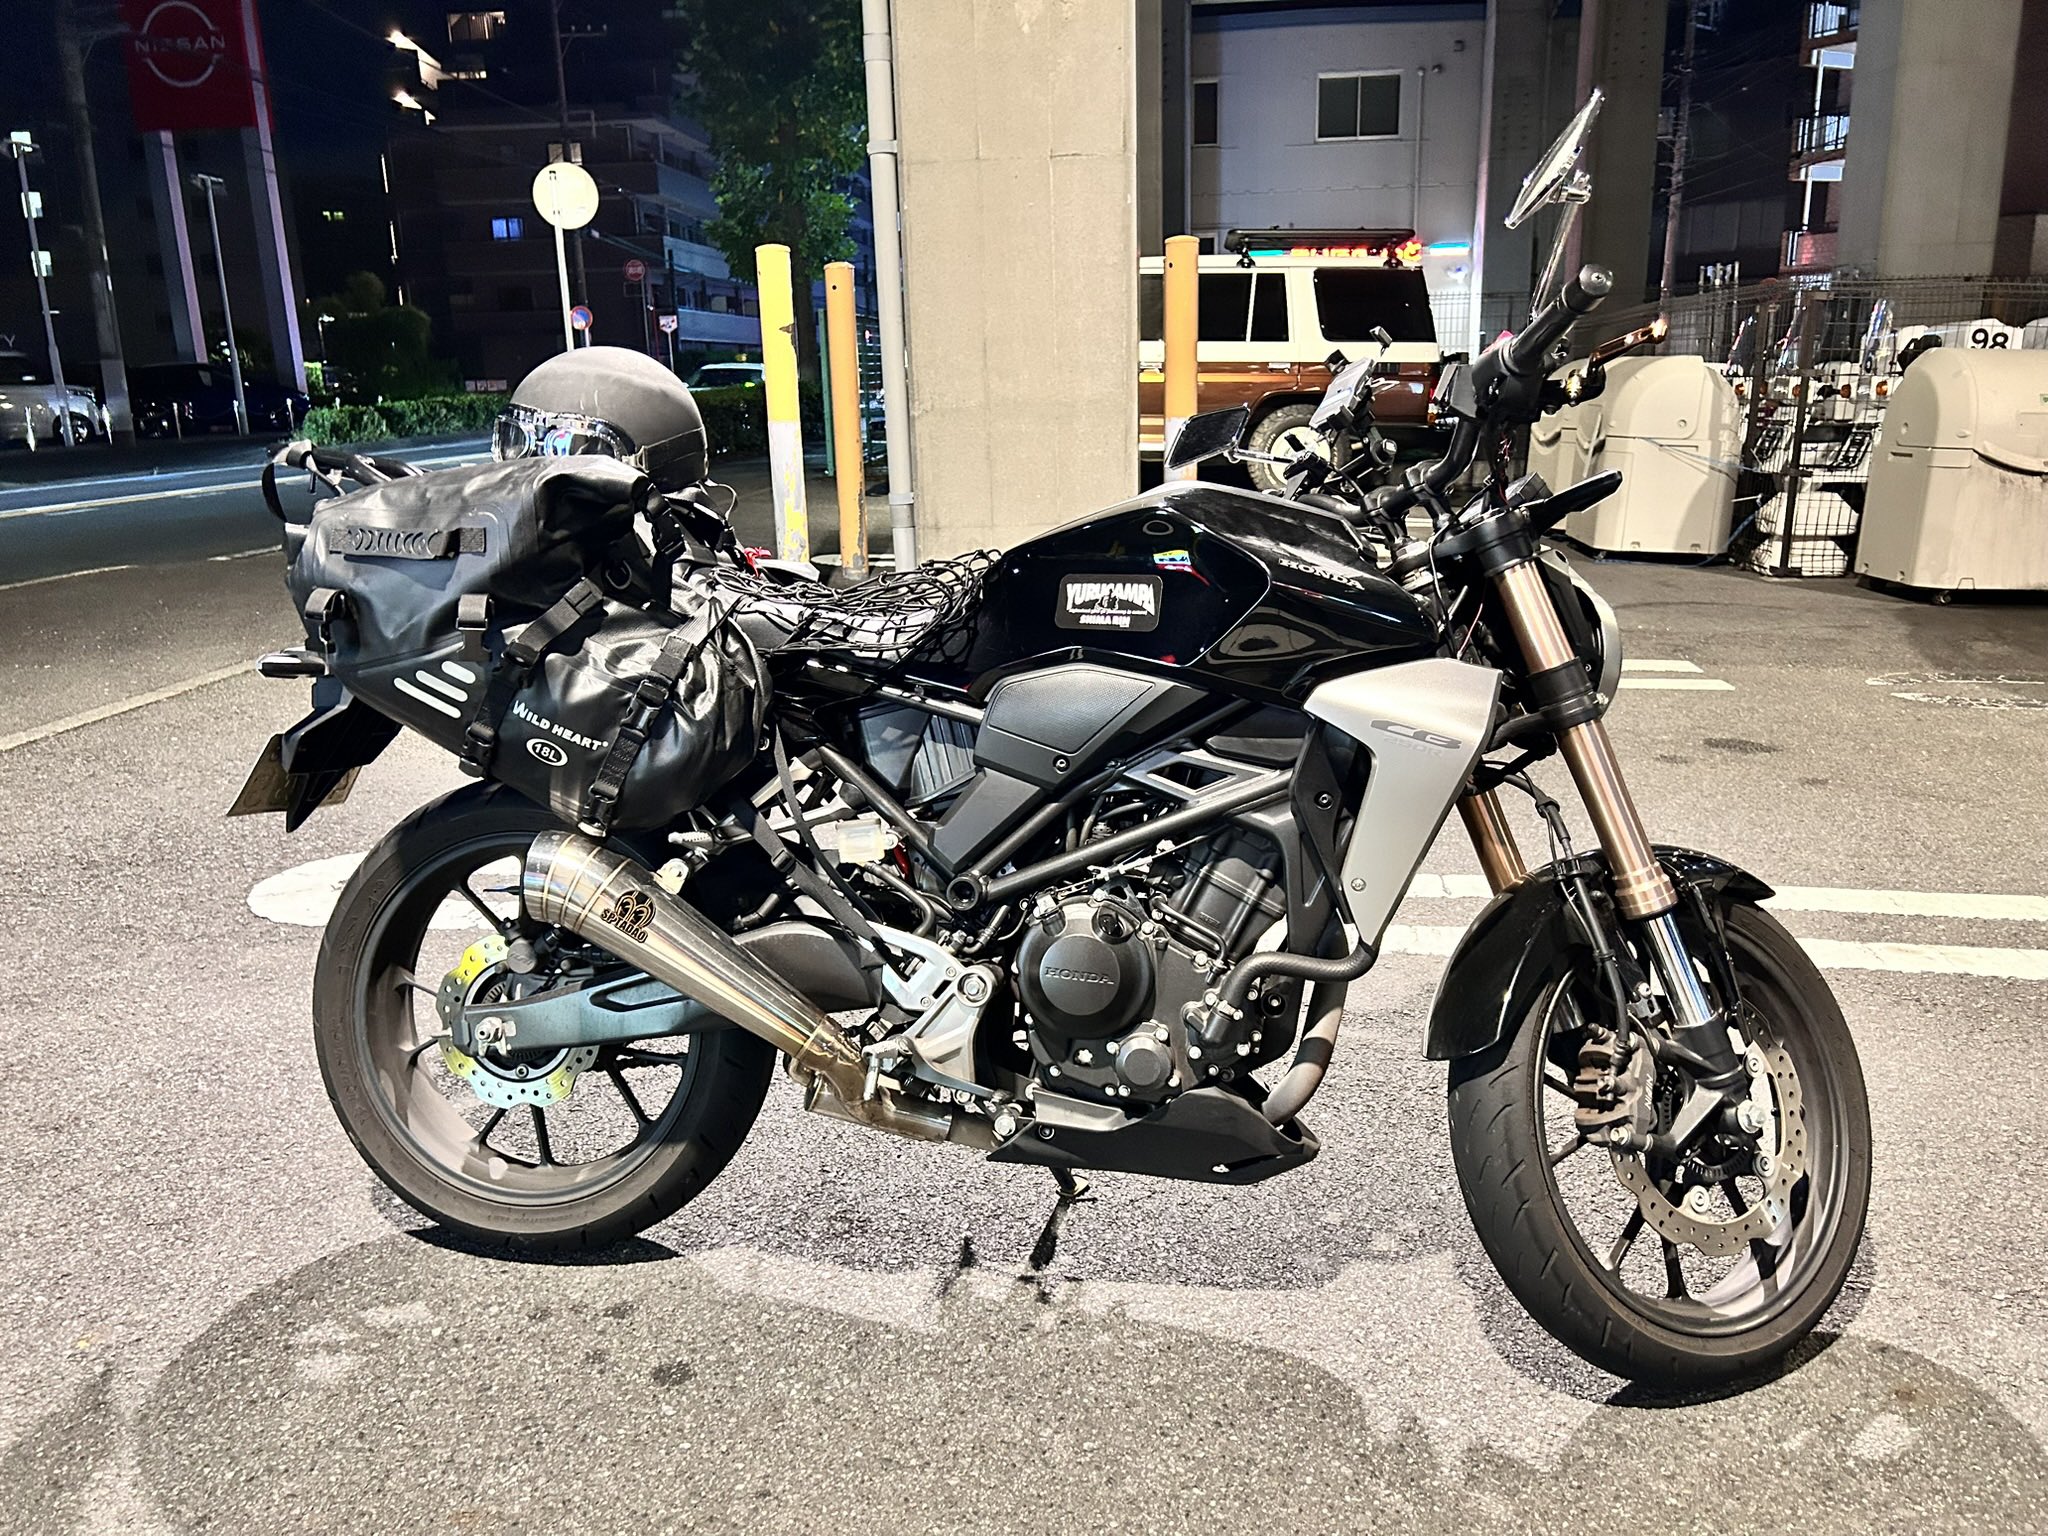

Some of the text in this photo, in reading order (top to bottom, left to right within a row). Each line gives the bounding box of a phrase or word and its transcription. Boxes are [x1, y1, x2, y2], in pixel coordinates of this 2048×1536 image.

[134, 34, 225, 53] NISSAN
[1971, 327, 2009, 349] 98
[1278, 557, 1366, 591] HONDA
[512, 699, 604, 752] WILD HEART
[1370, 719, 1463, 749] CB
[533, 742, 559, 763] 18L
[1044, 966, 1115, 985] HONDA
